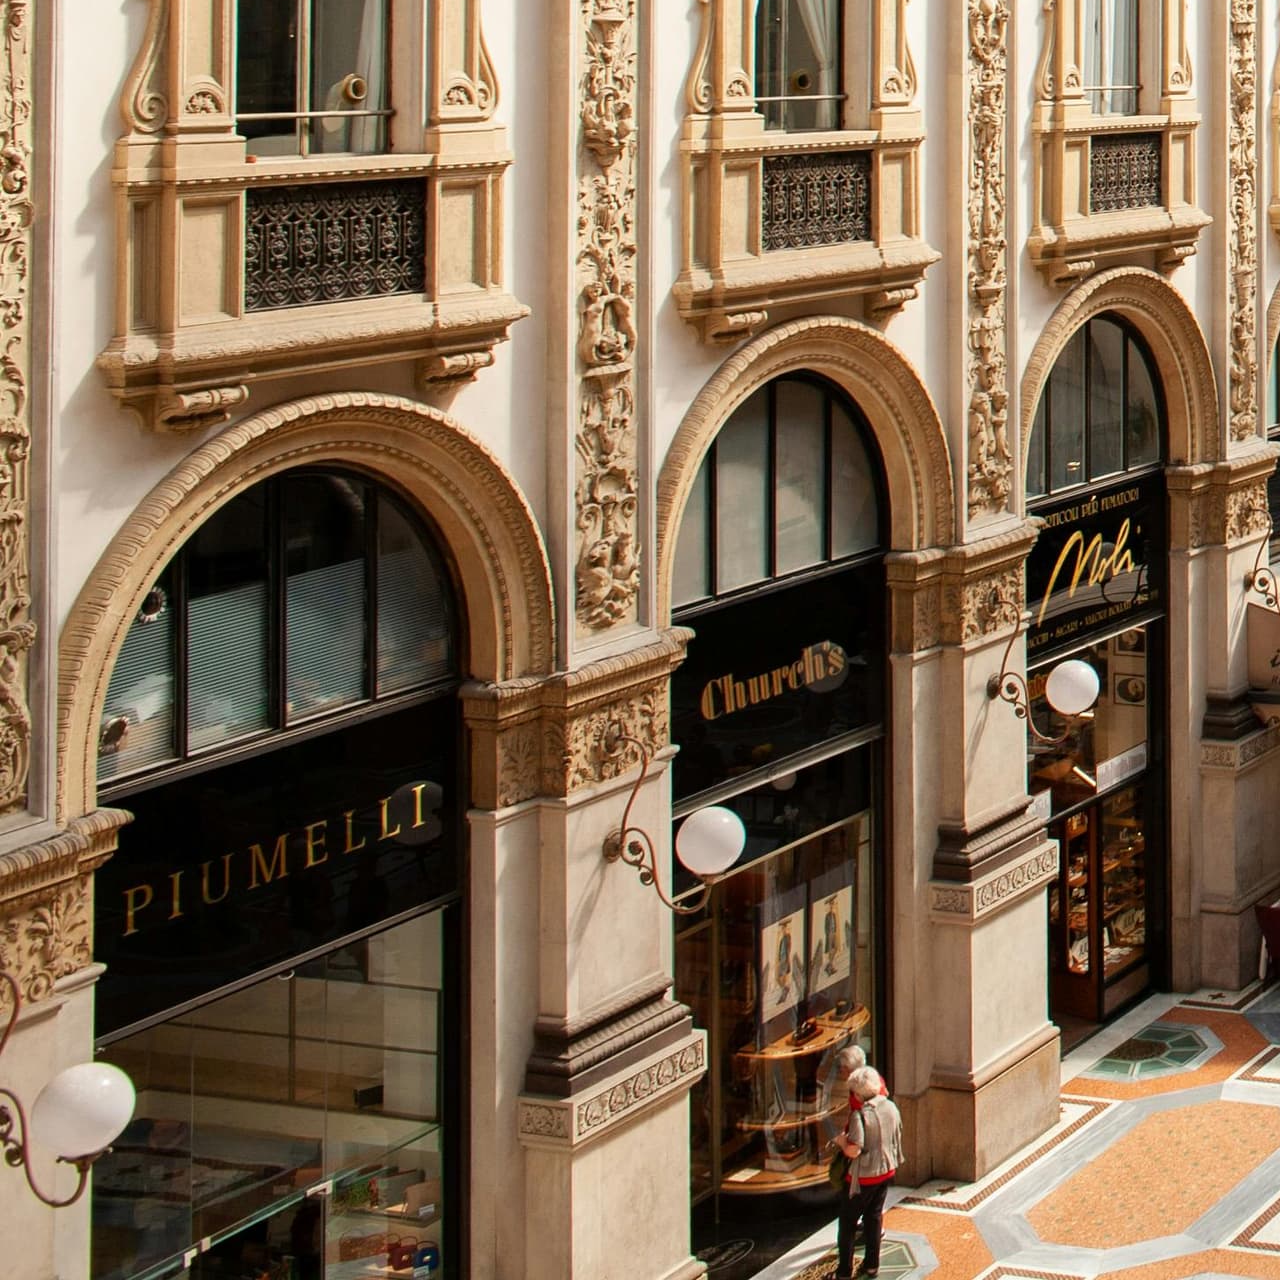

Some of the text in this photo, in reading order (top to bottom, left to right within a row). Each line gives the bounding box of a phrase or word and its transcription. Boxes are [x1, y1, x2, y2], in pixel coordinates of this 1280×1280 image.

[1043, 505, 1080, 529] RTICOLI
[701, 640, 846, 720] Church's
[121, 783, 427, 938] PIUMELLI
